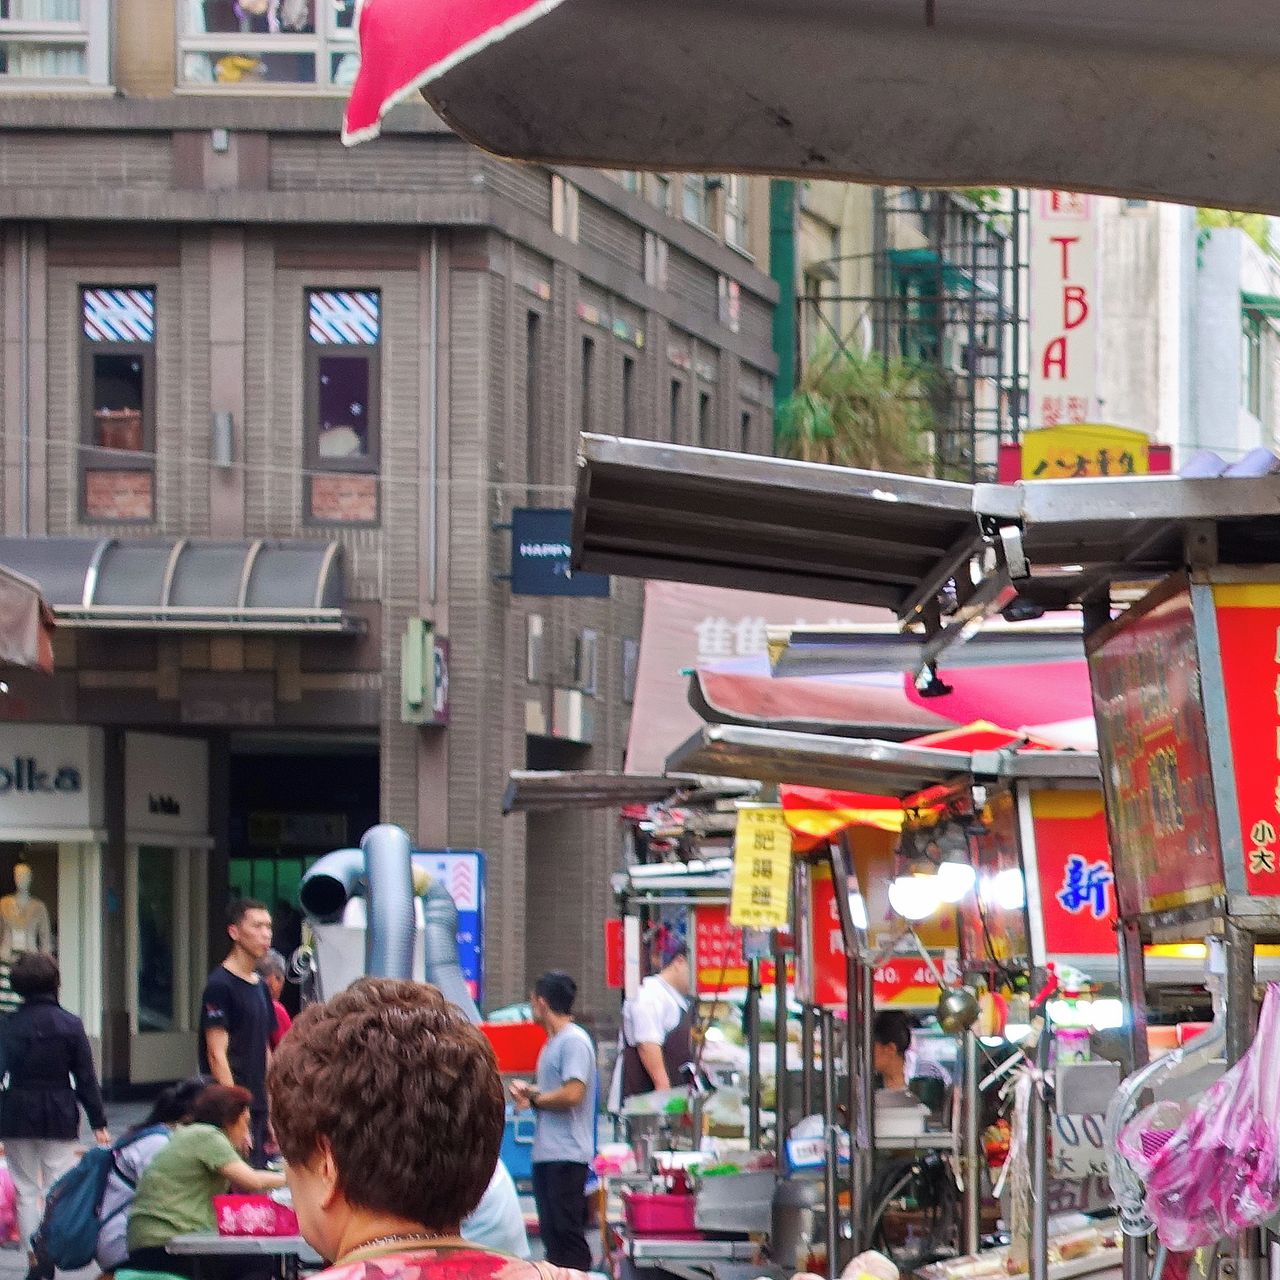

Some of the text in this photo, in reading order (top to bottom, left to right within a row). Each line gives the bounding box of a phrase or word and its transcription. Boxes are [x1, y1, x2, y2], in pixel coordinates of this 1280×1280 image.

[1251, 821, 1276, 847] 小
[1249, 847, 1276, 873] 大
[1060, 855, 1113, 920] 新
